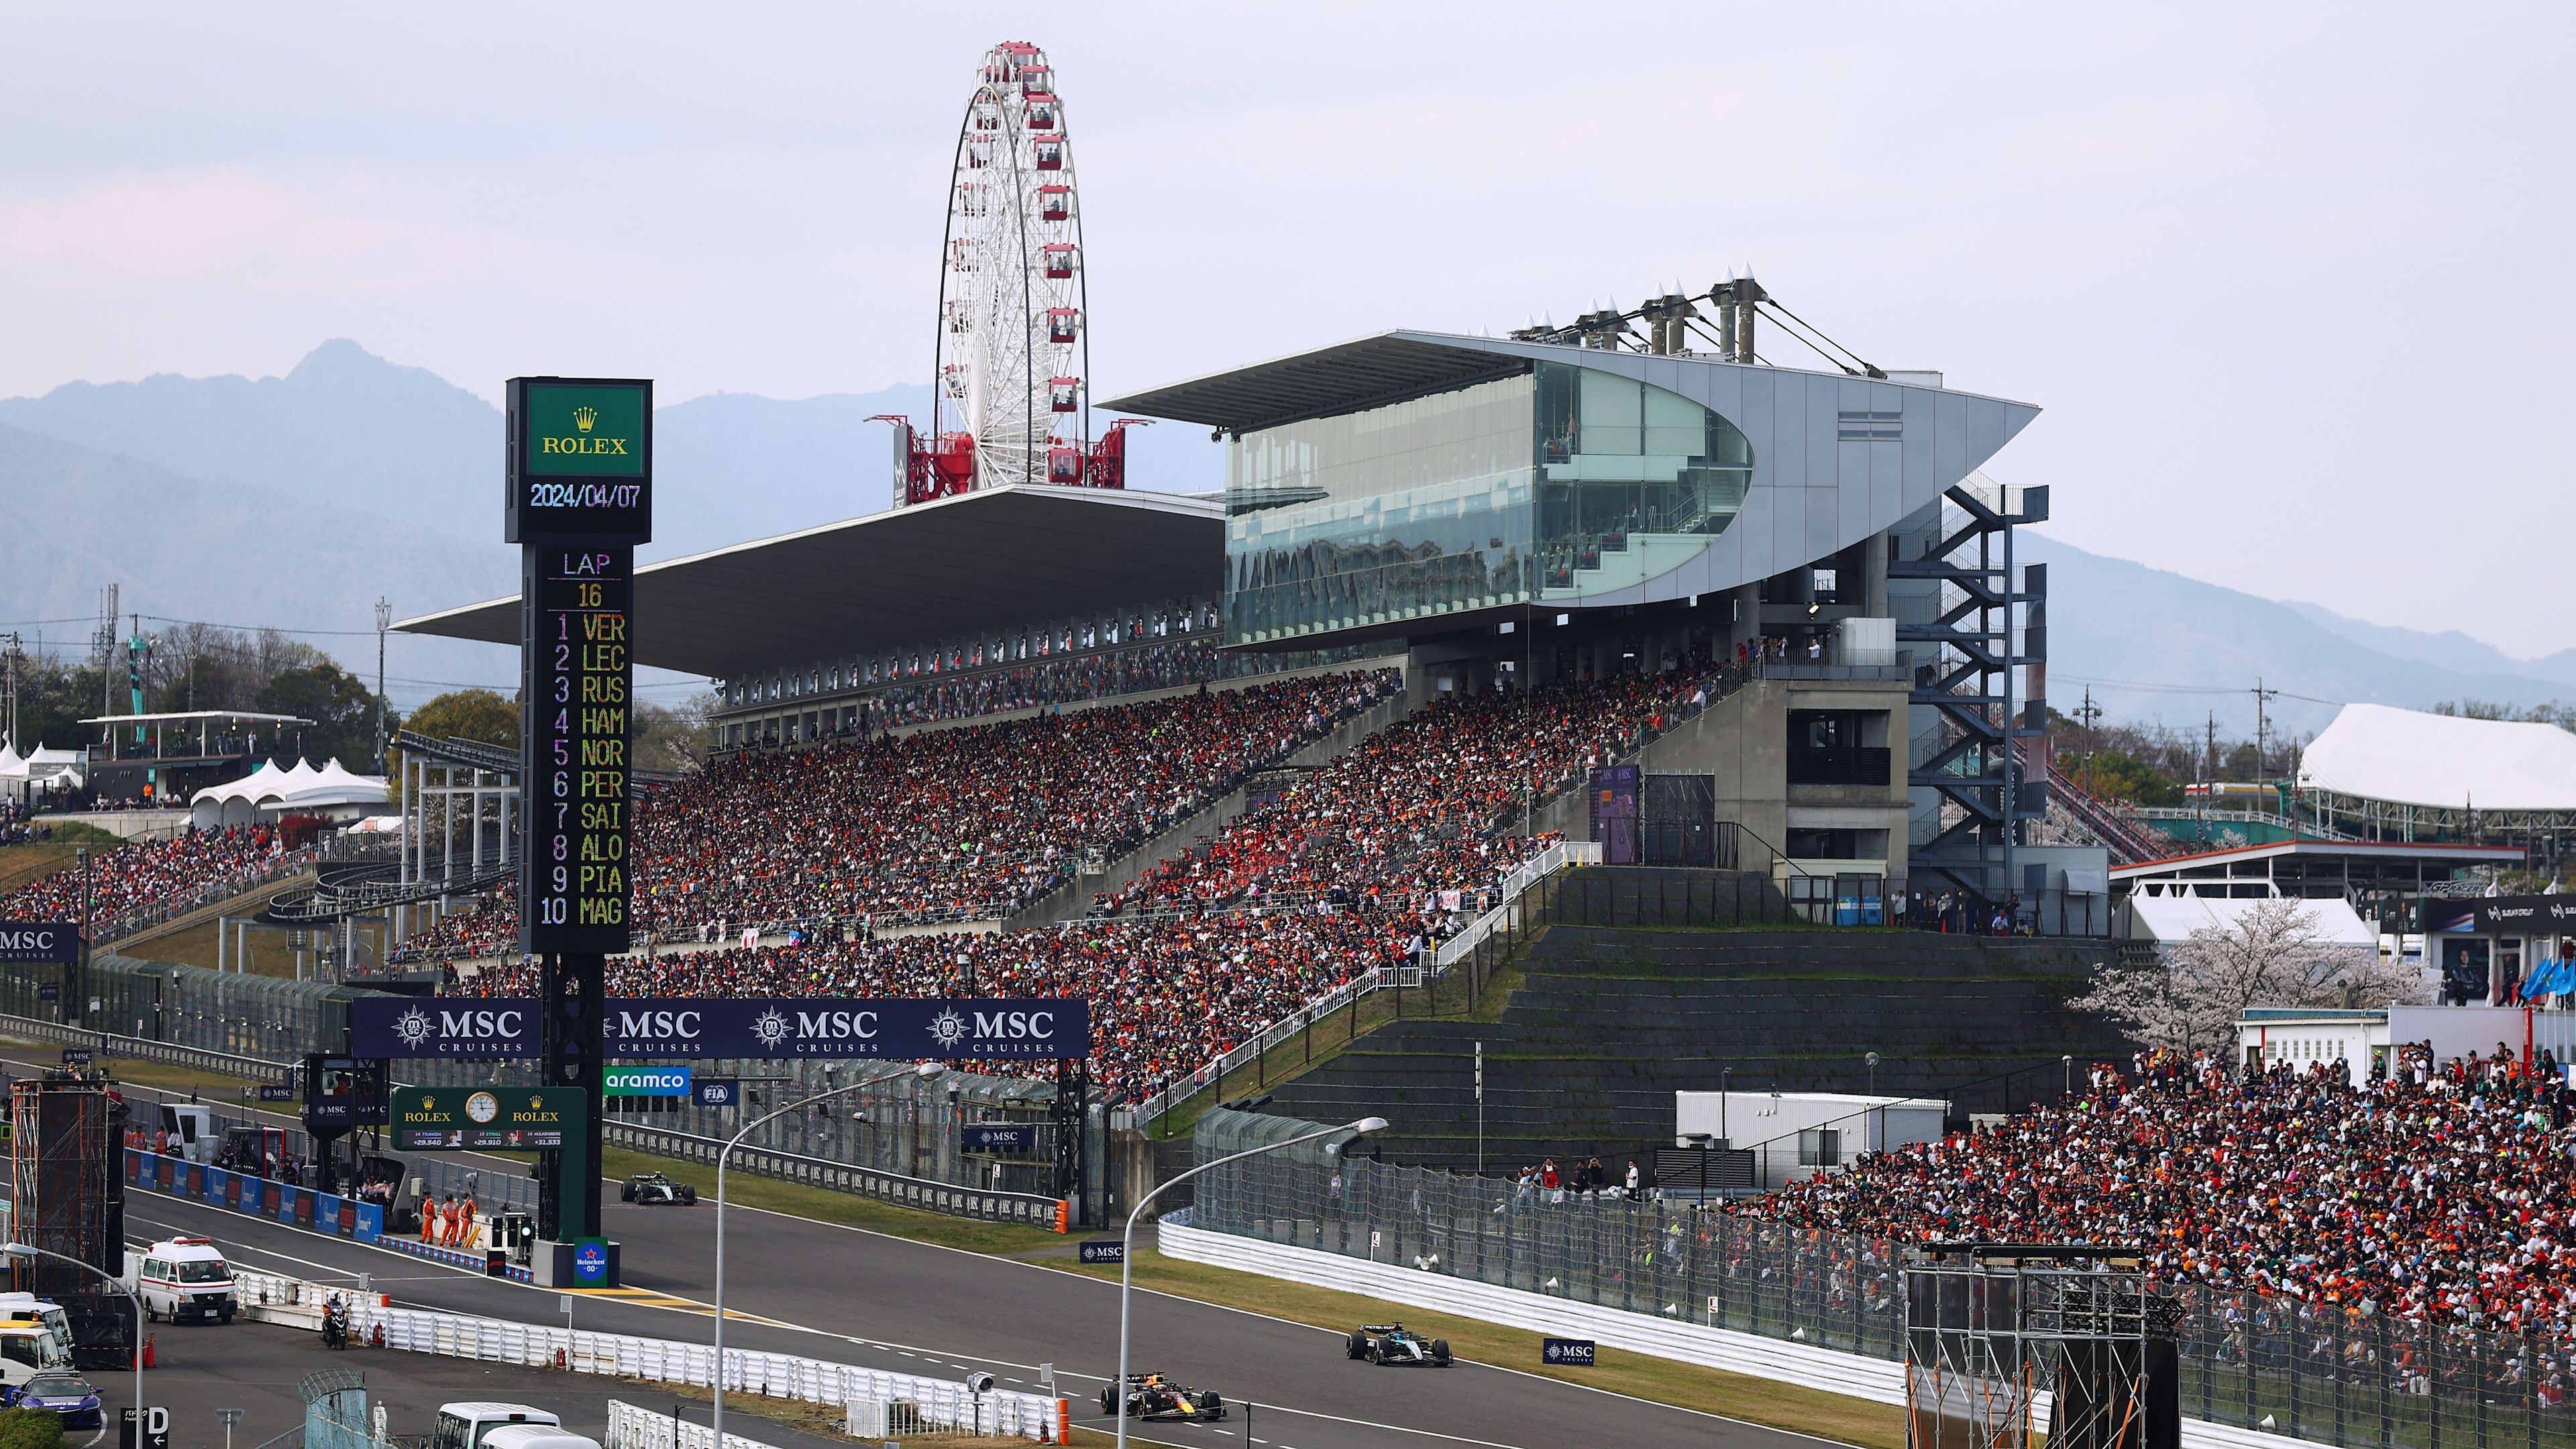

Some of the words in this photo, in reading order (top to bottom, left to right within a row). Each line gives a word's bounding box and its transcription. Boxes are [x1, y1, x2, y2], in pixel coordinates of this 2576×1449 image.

[542, 437, 628, 455] ROLEX
[531, 483, 641, 508] 2024/04/07
[564, 553, 610, 575] LAP
[578, 582, 602, 607] 16
[558, 613, 568, 641] 1
[582, 613, 625, 641] VER
[555, 643, 570, 671] 2
[583, 644, 625, 672] LEC
[554, 676, 570, 703] 3
[582, 676, 624, 704] RUS
[554, 707, 569, 735] 4
[582, 708, 624, 735] HAM
[554, 739, 569, 766] 5
[582, 739, 624, 766] NOR
[554, 771, 568, 798] 6
[581, 771, 623, 798] PER
[1622, 768, 1631, 779] MSC
[553, 802, 568, 829] 7
[581, 802, 621, 830] SAI
[553, 834, 568, 861] 8
[580, 834, 623, 861] ALO
[553, 865, 568, 893] 9
[580, 865, 623, 893] PIA
[541, 897, 567, 924] 10
[580, 897, 622, 924] MAG
[0, 931, 54, 949] MSC
[439, 1011, 522, 1038] MSC
[619, 1011, 700, 1038] MSC
[797, 1011, 877, 1038] MSC
[973, 1011, 1053, 1039] MSC
[439, 1043, 522, 1052] CRUISES
[619, 1043, 700, 1052] CRUISES
[797, 1043, 878, 1052] CRUISES
[973, 1043, 1054, 1052] CRUISES
[606, 1074, 684, 1088] aramco
[405, 1112, 451, 1122] ROLEX
[513, 1112, 559, 1122] ROLEX
[993, 1132, 1018, 1141] MSC
[1097, 1247, 1122, 1256] MSC
[1562, 1346, 1593, 1357] MSC
[148, 1407, 169, 1434] D
